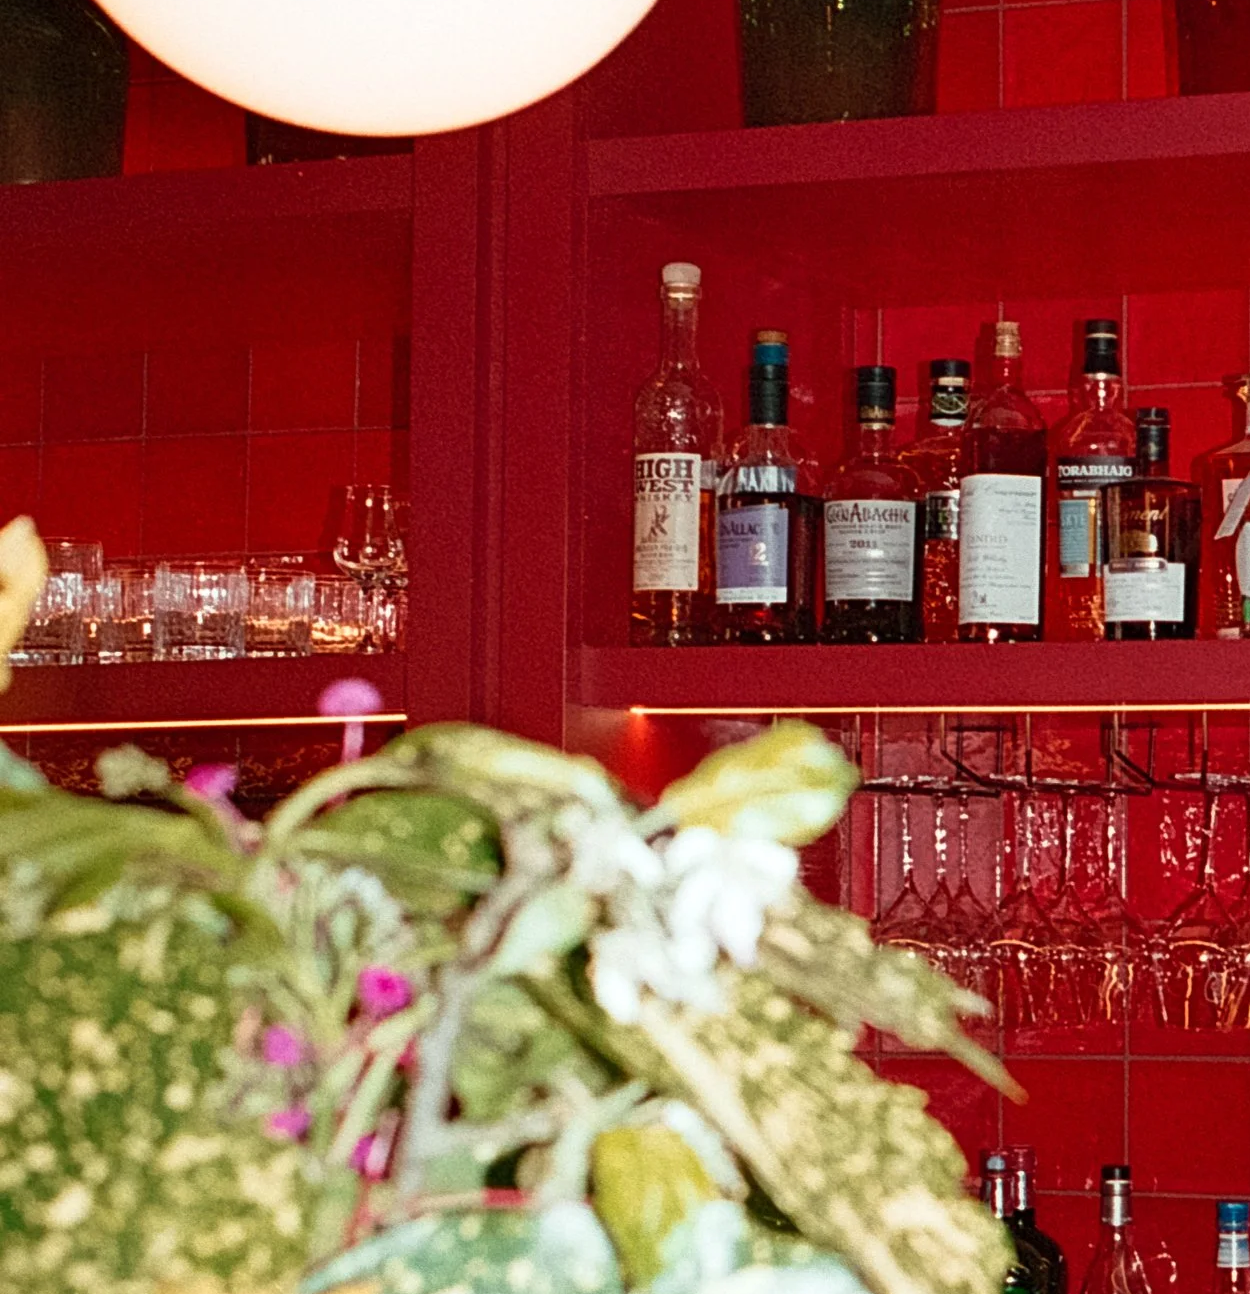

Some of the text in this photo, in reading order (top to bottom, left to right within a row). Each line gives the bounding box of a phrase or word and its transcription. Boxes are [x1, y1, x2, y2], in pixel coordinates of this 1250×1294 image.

[636, 457, 694, 479] HIGH
[1058, 465, 1132, 477] TORABHAIG
[636, 479, 694, 493] WEST
